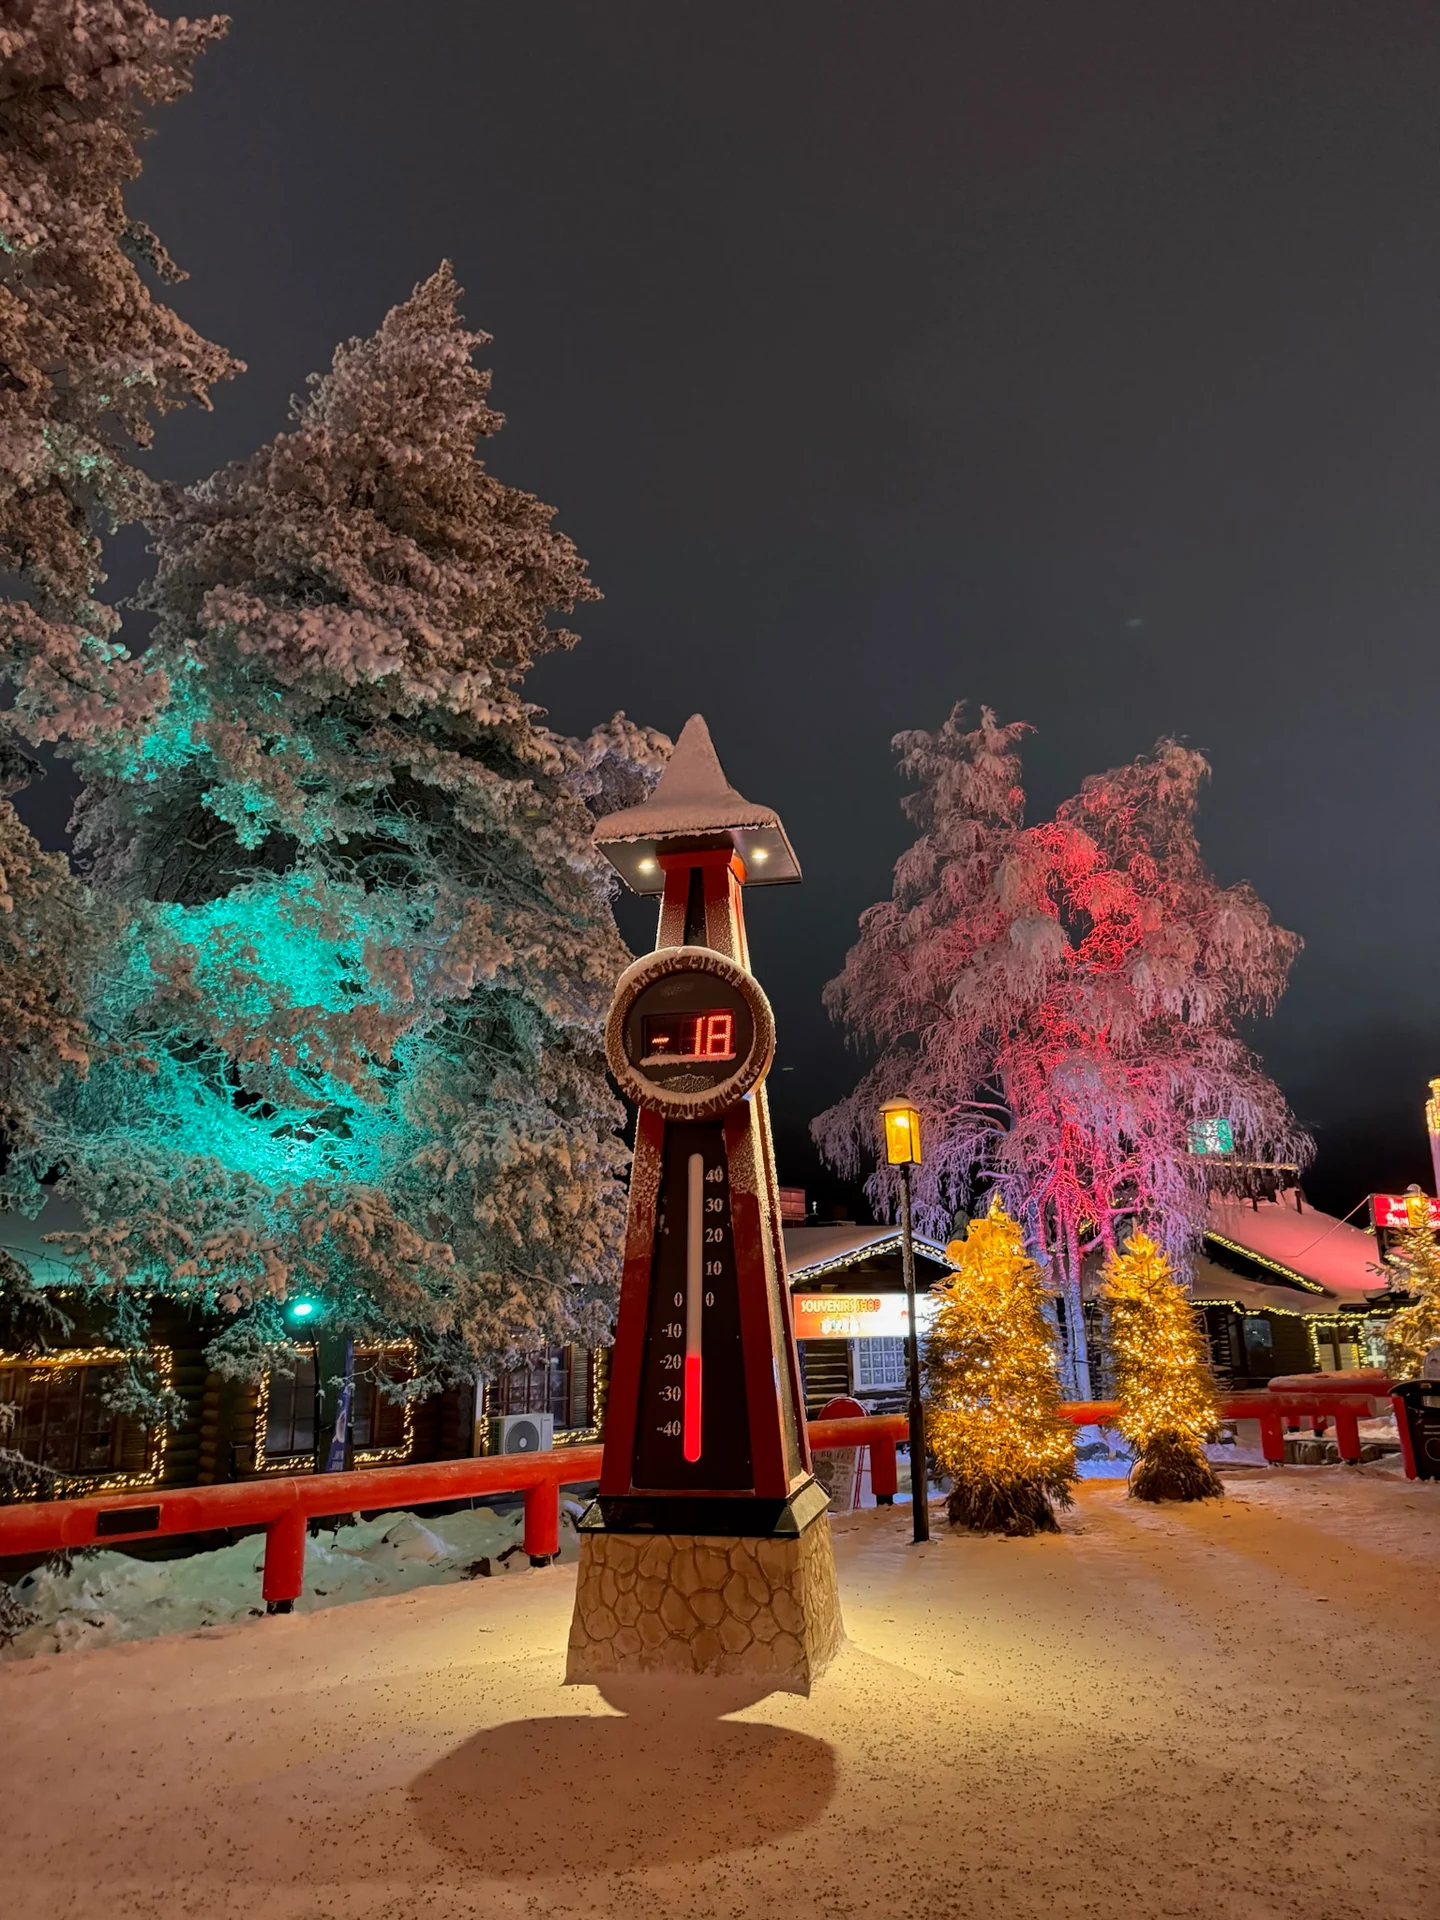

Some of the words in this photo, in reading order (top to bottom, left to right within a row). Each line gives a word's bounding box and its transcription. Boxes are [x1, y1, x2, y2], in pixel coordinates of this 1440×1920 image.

[687, 955, 745, 988] CIRCLE
[658, 1102, 705, 1120] CLAUS
[705, 1165, 724, 1183] 40
[705, 1198, 724, 1212] 30
[705, 1227, 723, 1243] 20
[705, 1260, 722, 1275] 10
[674, 1292, 683, 1307] 0
[705, 1292, 715, 1307] 0
[801, 1298, 855, 1313] SOUVENIRS
[856, 1298, 881, 1313] SHOP
[661, 1323, 682, 1338] -10
[660, 1354, 682, 1369] -20
[658, 1386, 682, 1401] -30
[656, 1420, 682, 1436] -40
